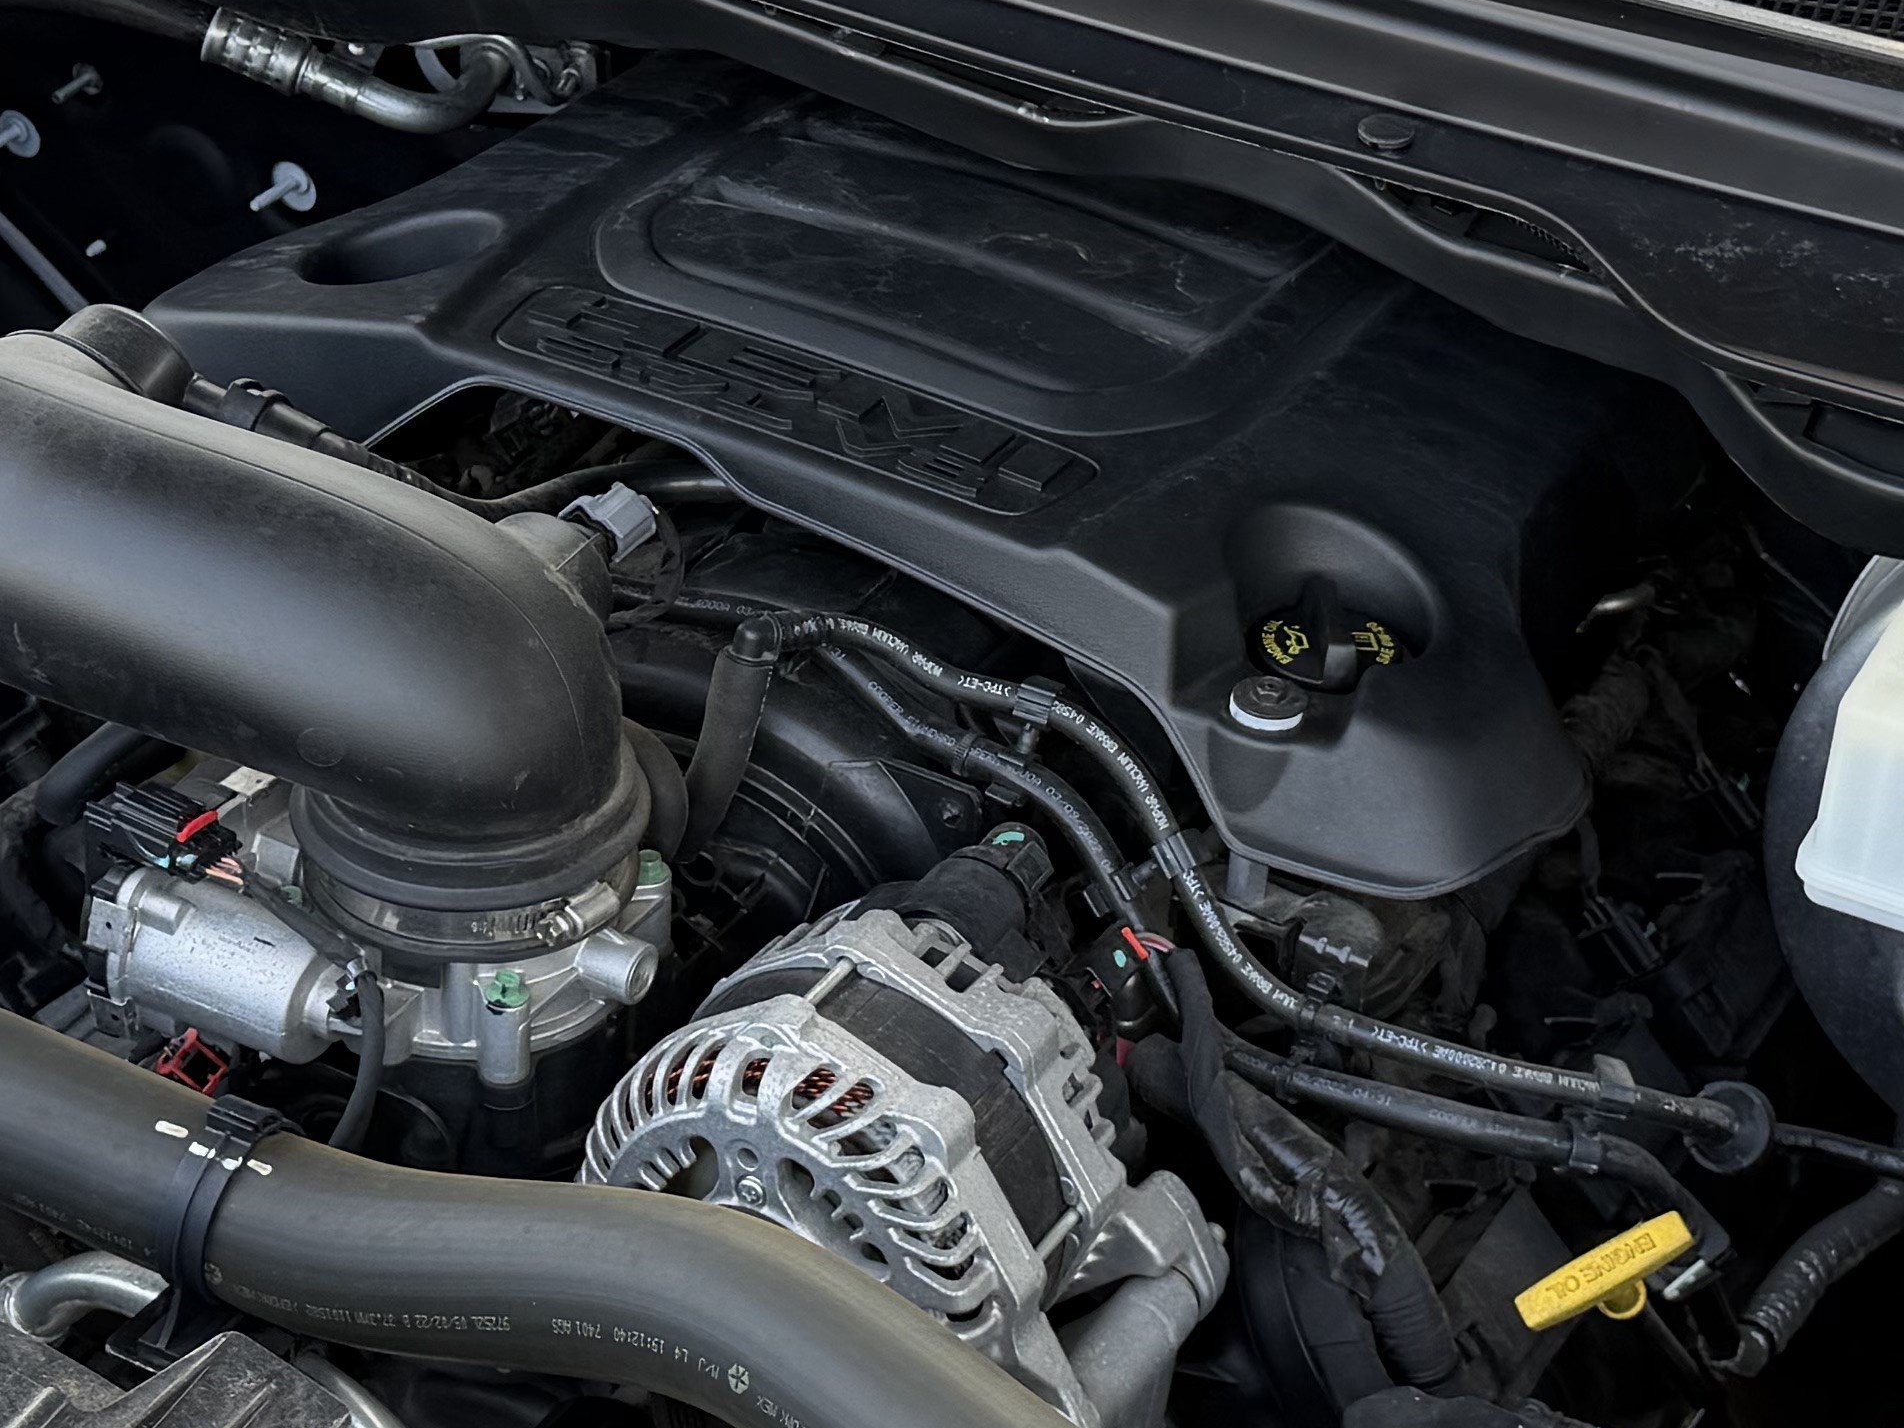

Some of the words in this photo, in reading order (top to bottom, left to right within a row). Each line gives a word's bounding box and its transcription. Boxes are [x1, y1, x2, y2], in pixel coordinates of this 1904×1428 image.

[1085, 722, 1119, 753] BRAKE
[1116, 752, 1150, 794] VACUUM
[1143, 794, 1171, 830] MOPAR
[1579, 1232, 1657, 1284] ENGINE
[1545, 1273, 1582, 1302] OIL
[573, 1321, 604, 1338] 7401
[753, 1392, 781, 1418] MEX
